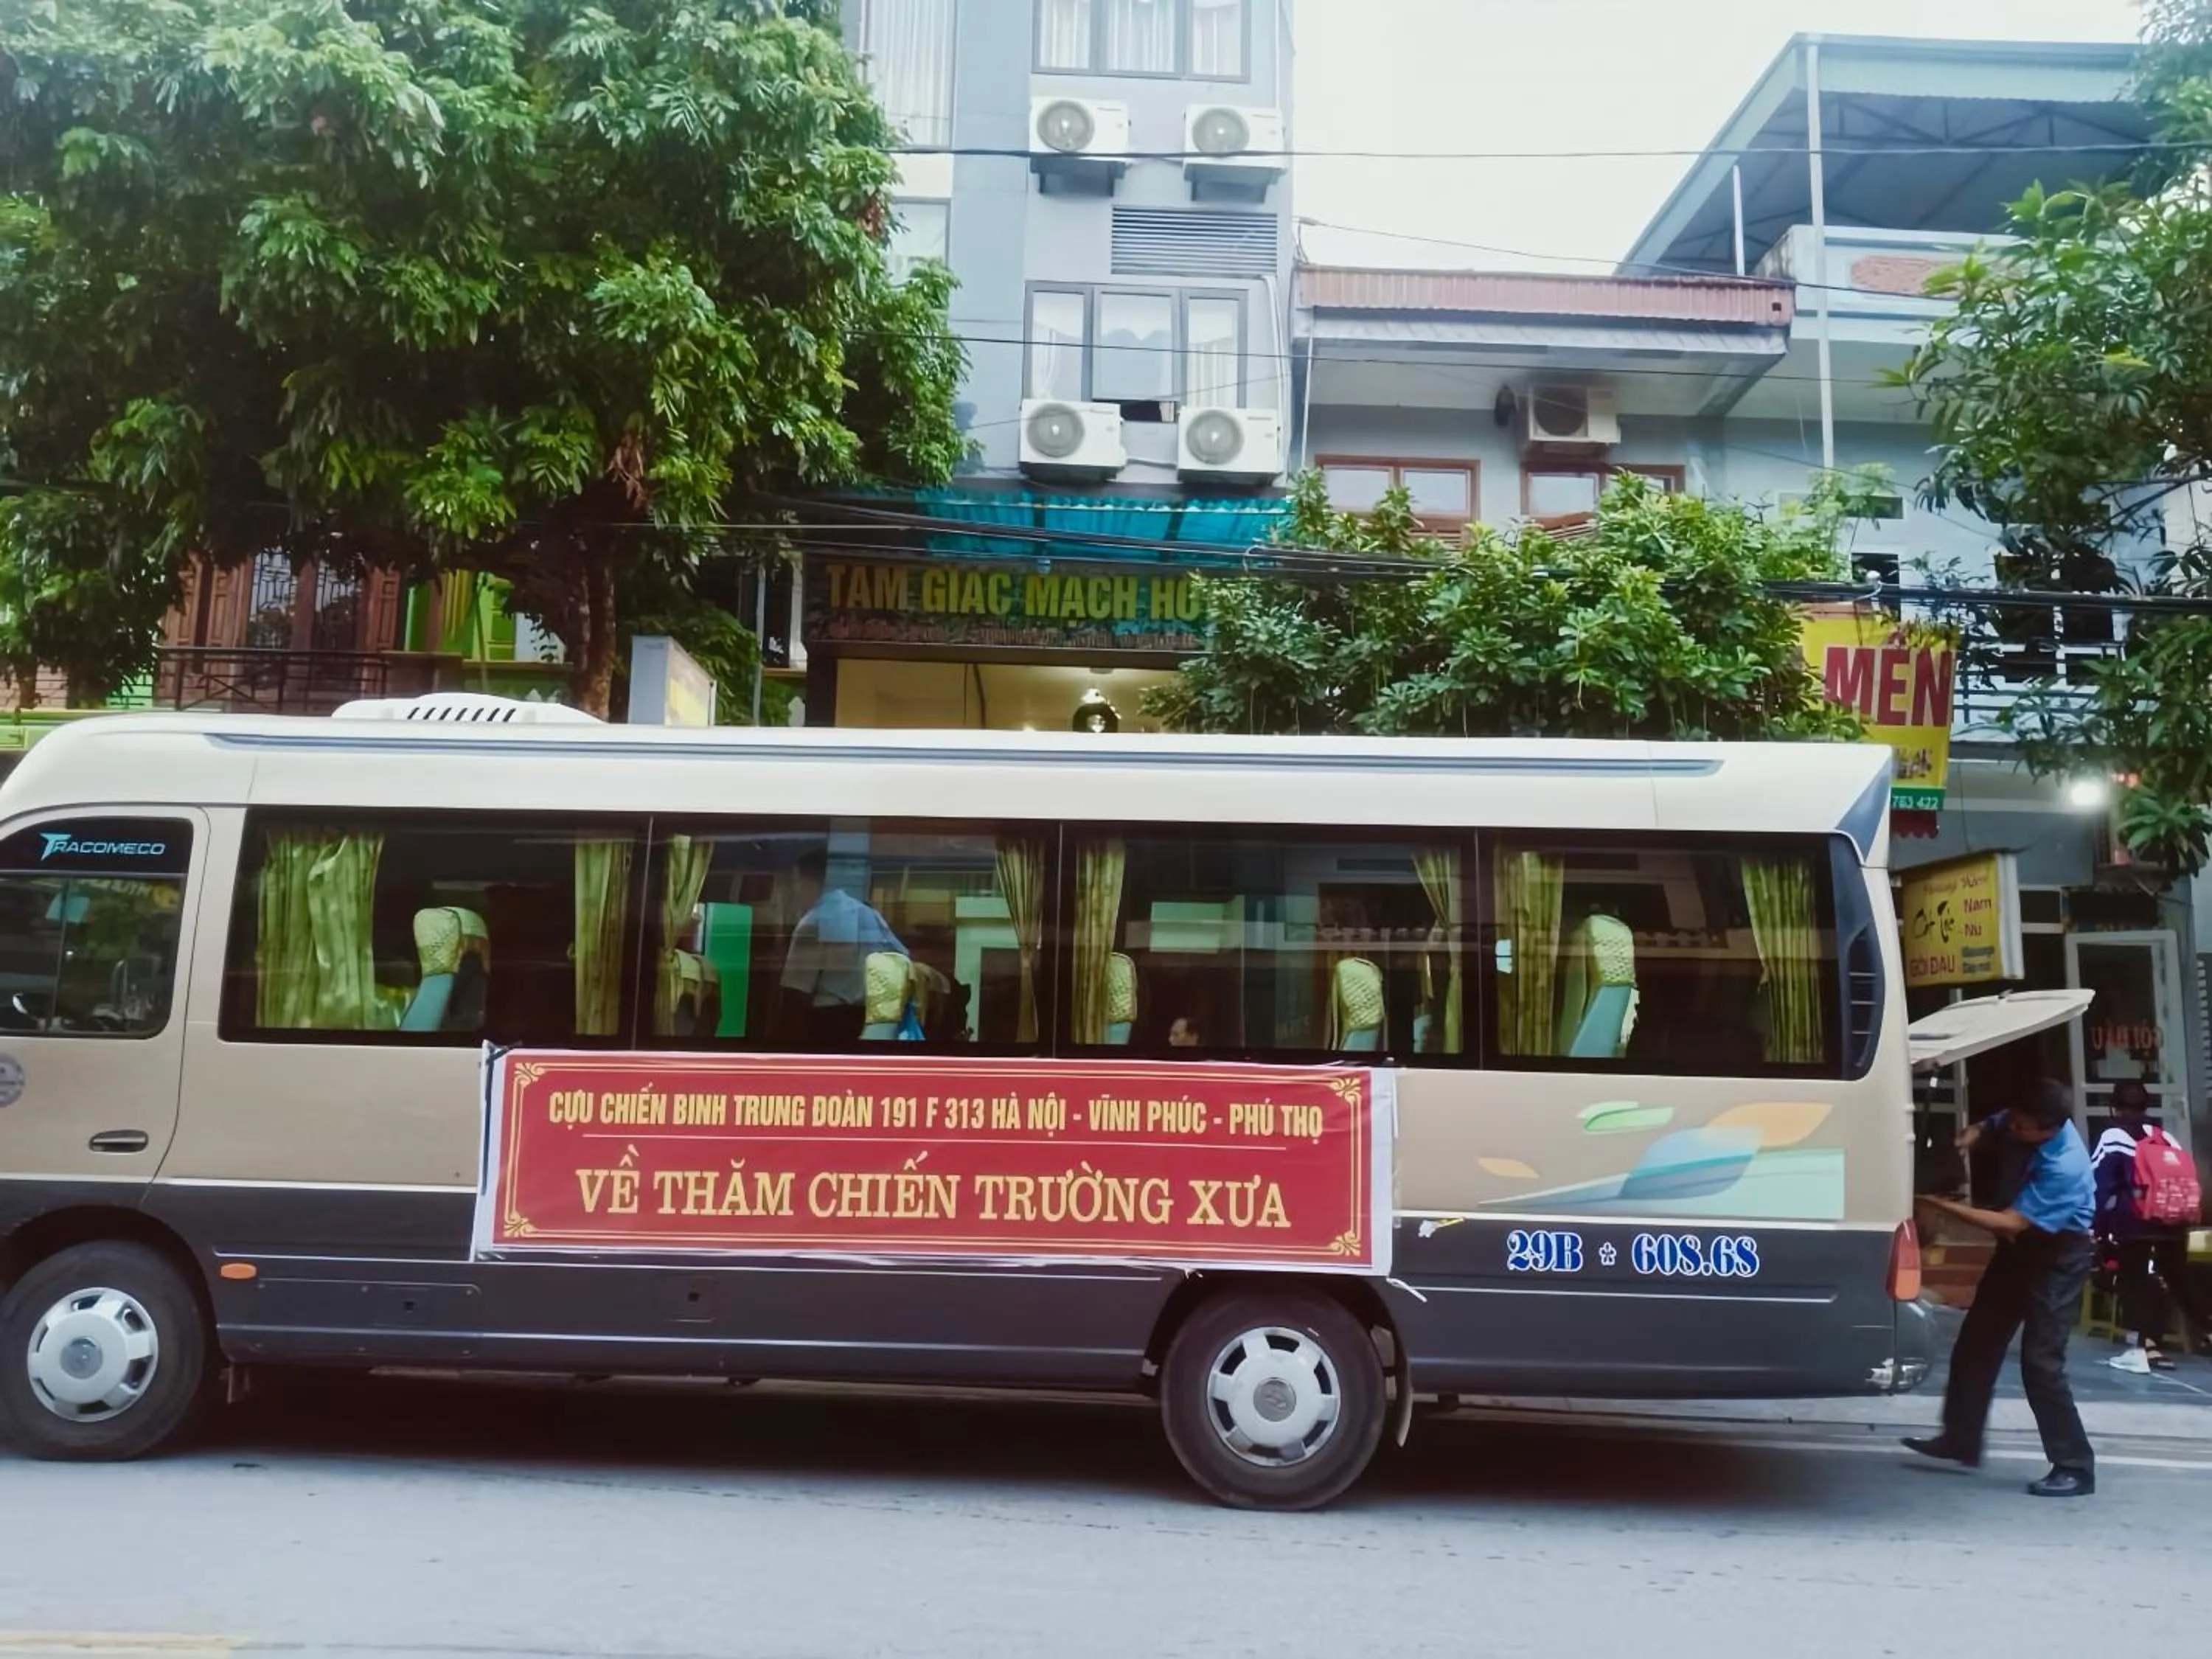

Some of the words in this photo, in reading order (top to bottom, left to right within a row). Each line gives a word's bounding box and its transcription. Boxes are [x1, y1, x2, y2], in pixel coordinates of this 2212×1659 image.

[825, 566, 909, 611] TAM
[38, 832, 166, 861] TRACOMECO
[549, 1090, 594, 1130] CỰU
[599, 1082, 667, 1124] CHIẾN
[672, 1093, 727, 1126] BINH
[733, 1094, 806, 1127] TRUNG
[811, 1089, 874, 1127] ĐOÀN
[880, 1096, 917, 1128] 191
[925, 1096, 939, 1128] F
[944, 1097, 985, 1130] 313
[991, 1091, 1022, 1130] HÀ
[1027, 1091, 1067, 1138] NỘI
[1088, 1093, 1141, 1132] VĨNH
[1147, 1094, 1207, 1134] PHÚC
[1213, 1116, 1223, 1124] -
[1229, 1097, 1275, 1136] PHÚ
[1280, 1105, 1324, 1145] THỌ
[575, 1144, 640, 1213] VỀ
[653, 1158, 796, 1216] THĂM
[808, 1150, 961, 1219] CHIẾN
[974, 1161, 1175, 1225] TRƯỜNG
[1186, 1174, 1292, 1228] XƯA
[1506, 1229, 1584, 1272] 29B
[1631, 1233, 1761, 1278] 608.68
